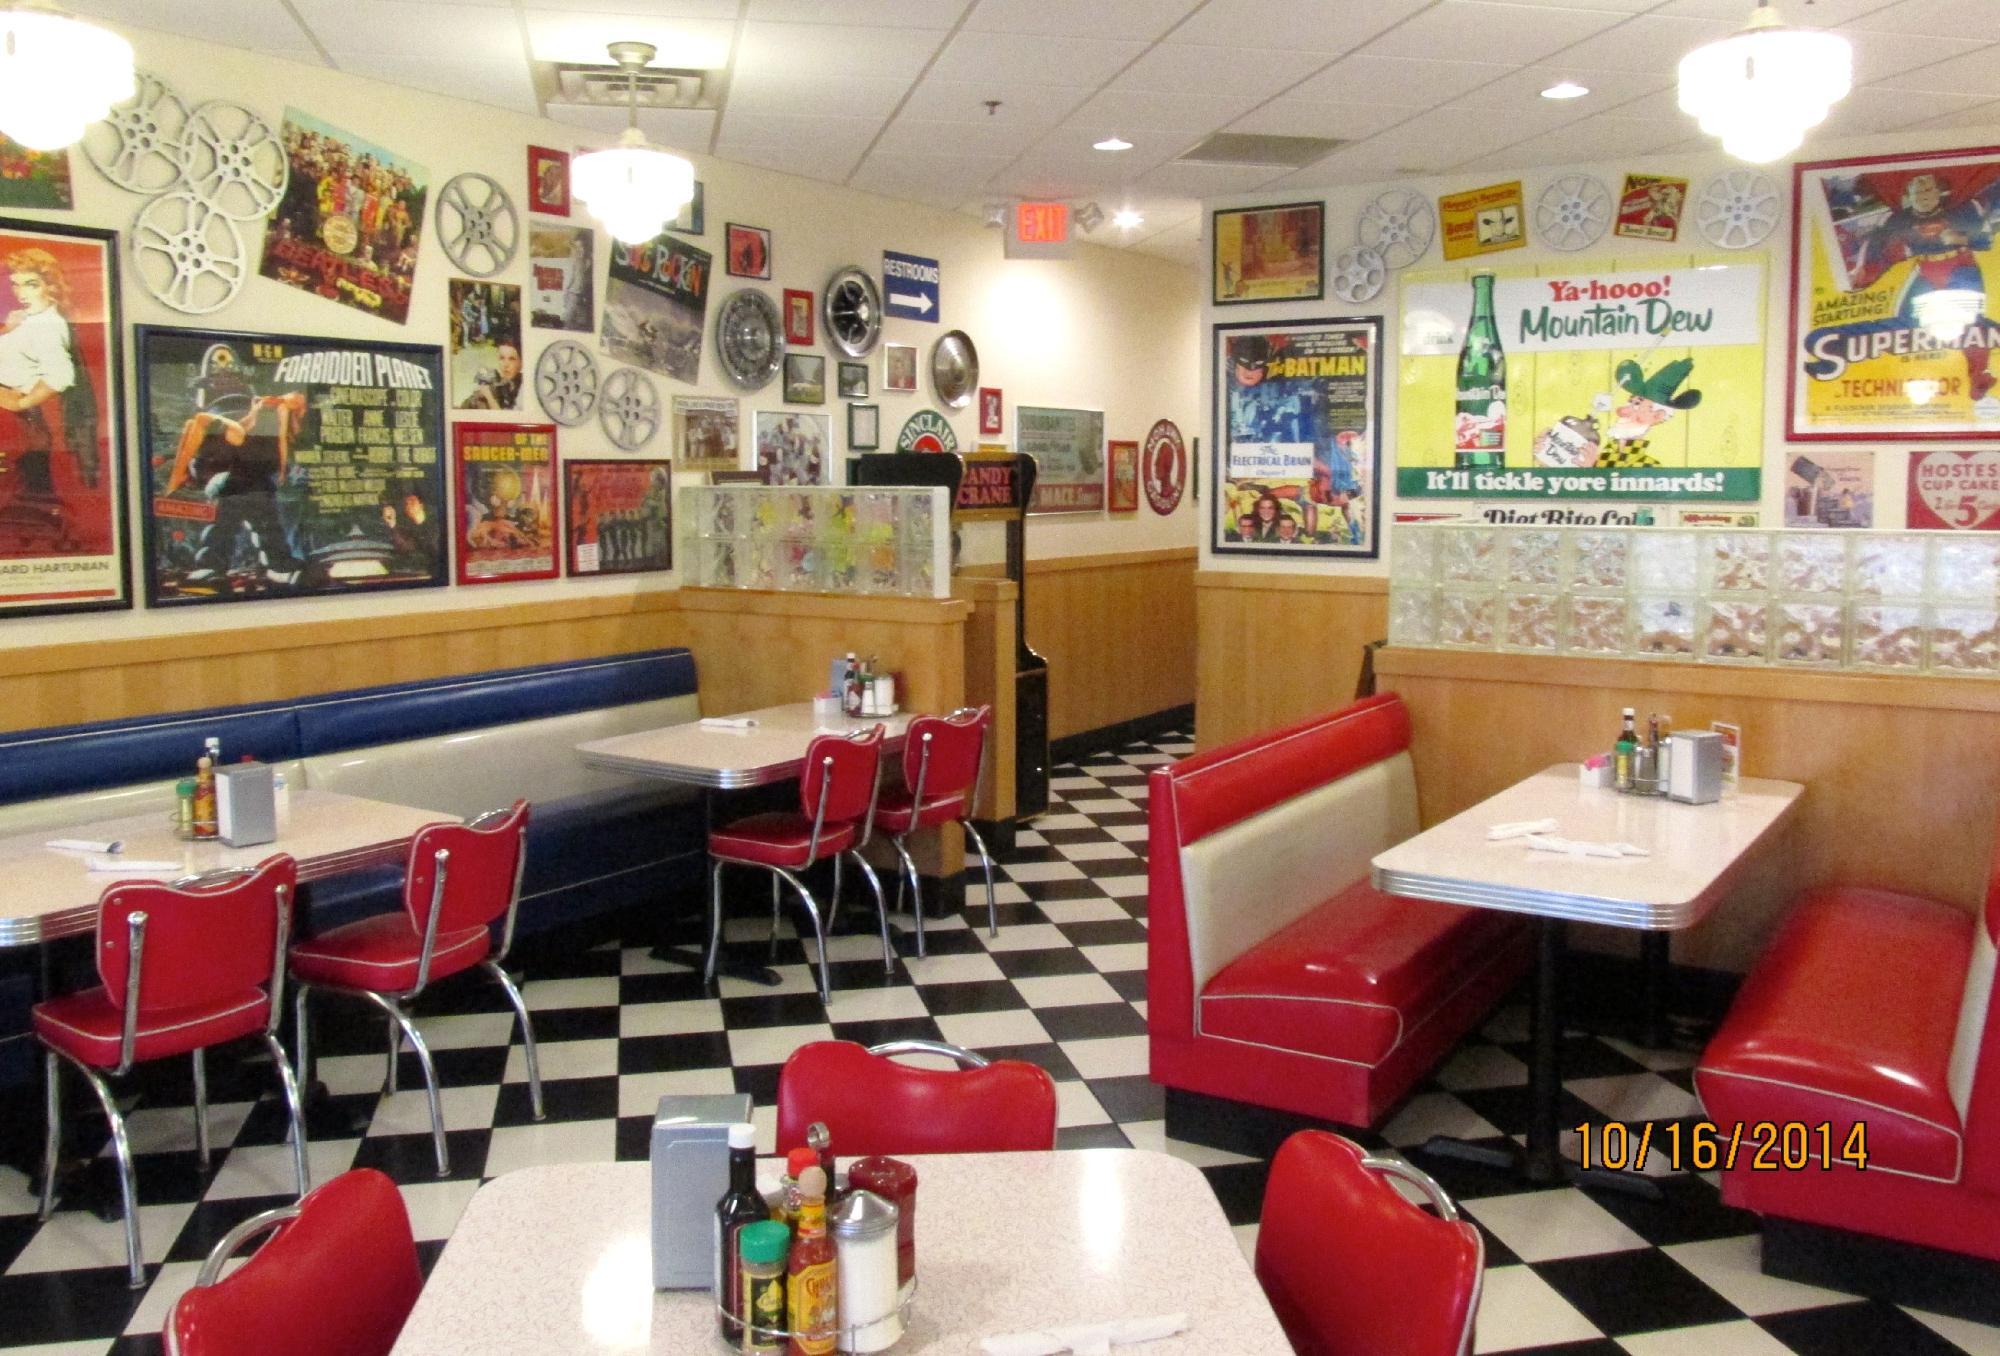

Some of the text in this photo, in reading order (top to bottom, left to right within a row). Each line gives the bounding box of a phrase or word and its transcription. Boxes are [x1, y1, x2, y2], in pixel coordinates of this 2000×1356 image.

[1019, 206, 1064, 241] EXIT
[884, 258, 938, 284] RESTROOMS
[1549, 275, 1671, 302] Ya-hooo!
[1814, 286, 1896, 312] AMAZING!
[1519, 298, 1713, 344] Mountain Dew
[1812, 301, 1891, 326] STARTLING!
[273, 351, 433, 390] FORBIDDEN PLANET
[1284, 355, 1366, 378] BATMAN
[1841, 376, 1962, 397] TECHNIOR
[900, 414, 955, 451] SINCLAIR
[1232, 454, 1312, 467] ELECTRICAL BRAIN
[1922, 463, 2000, 478] HOSTES
[966, 466, 1012, 486] ANDY
[1426, 470, 1726, 495] It'll tickle yore innards!
[1922, 480, 2000, 491] CUP CAKE
[1483, 509, 1538, 525] Diet
[1540, 509, 1597, 525] Rite
[1954, 495, 1979, 527] 5
[0, 564, 29, 575] ARD
